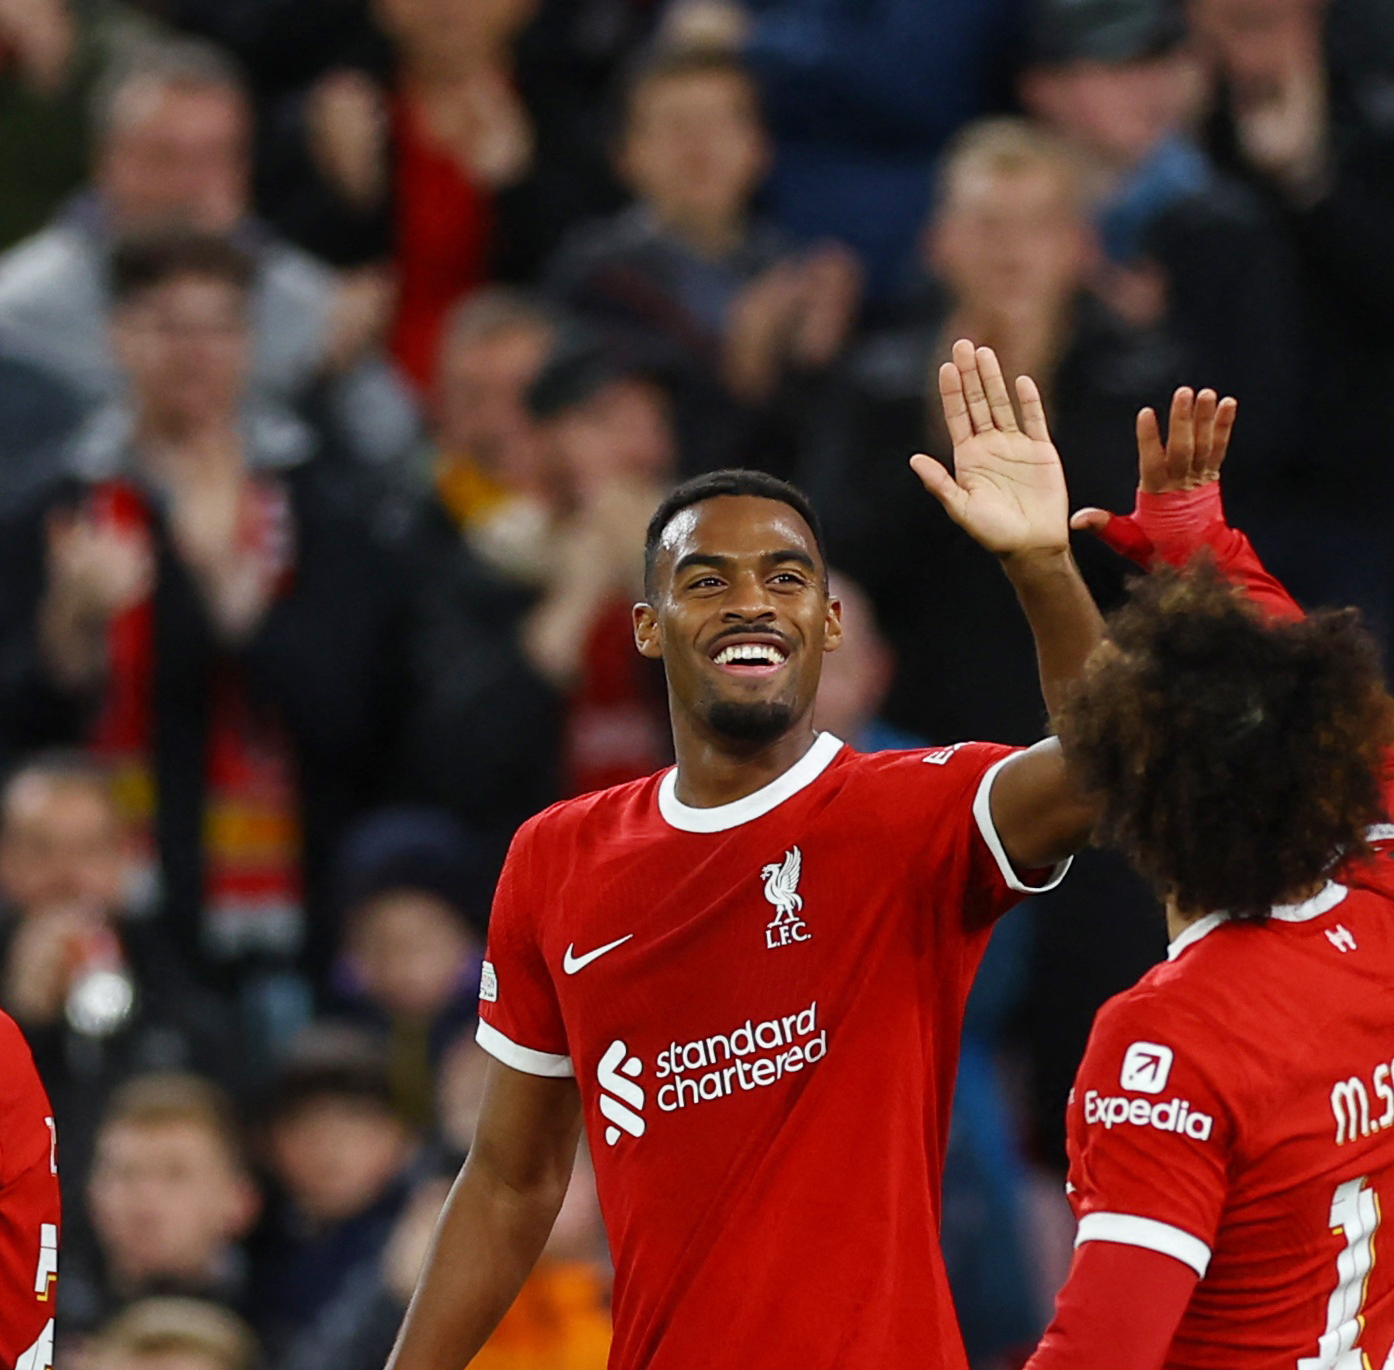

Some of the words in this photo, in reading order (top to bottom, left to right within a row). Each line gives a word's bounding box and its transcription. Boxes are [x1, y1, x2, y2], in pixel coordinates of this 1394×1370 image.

[656, 1000, 817, 1079] standard
[657, 1029, 827, 1112] chartered
[1084, 1089, 1213, 1142] Expedia
